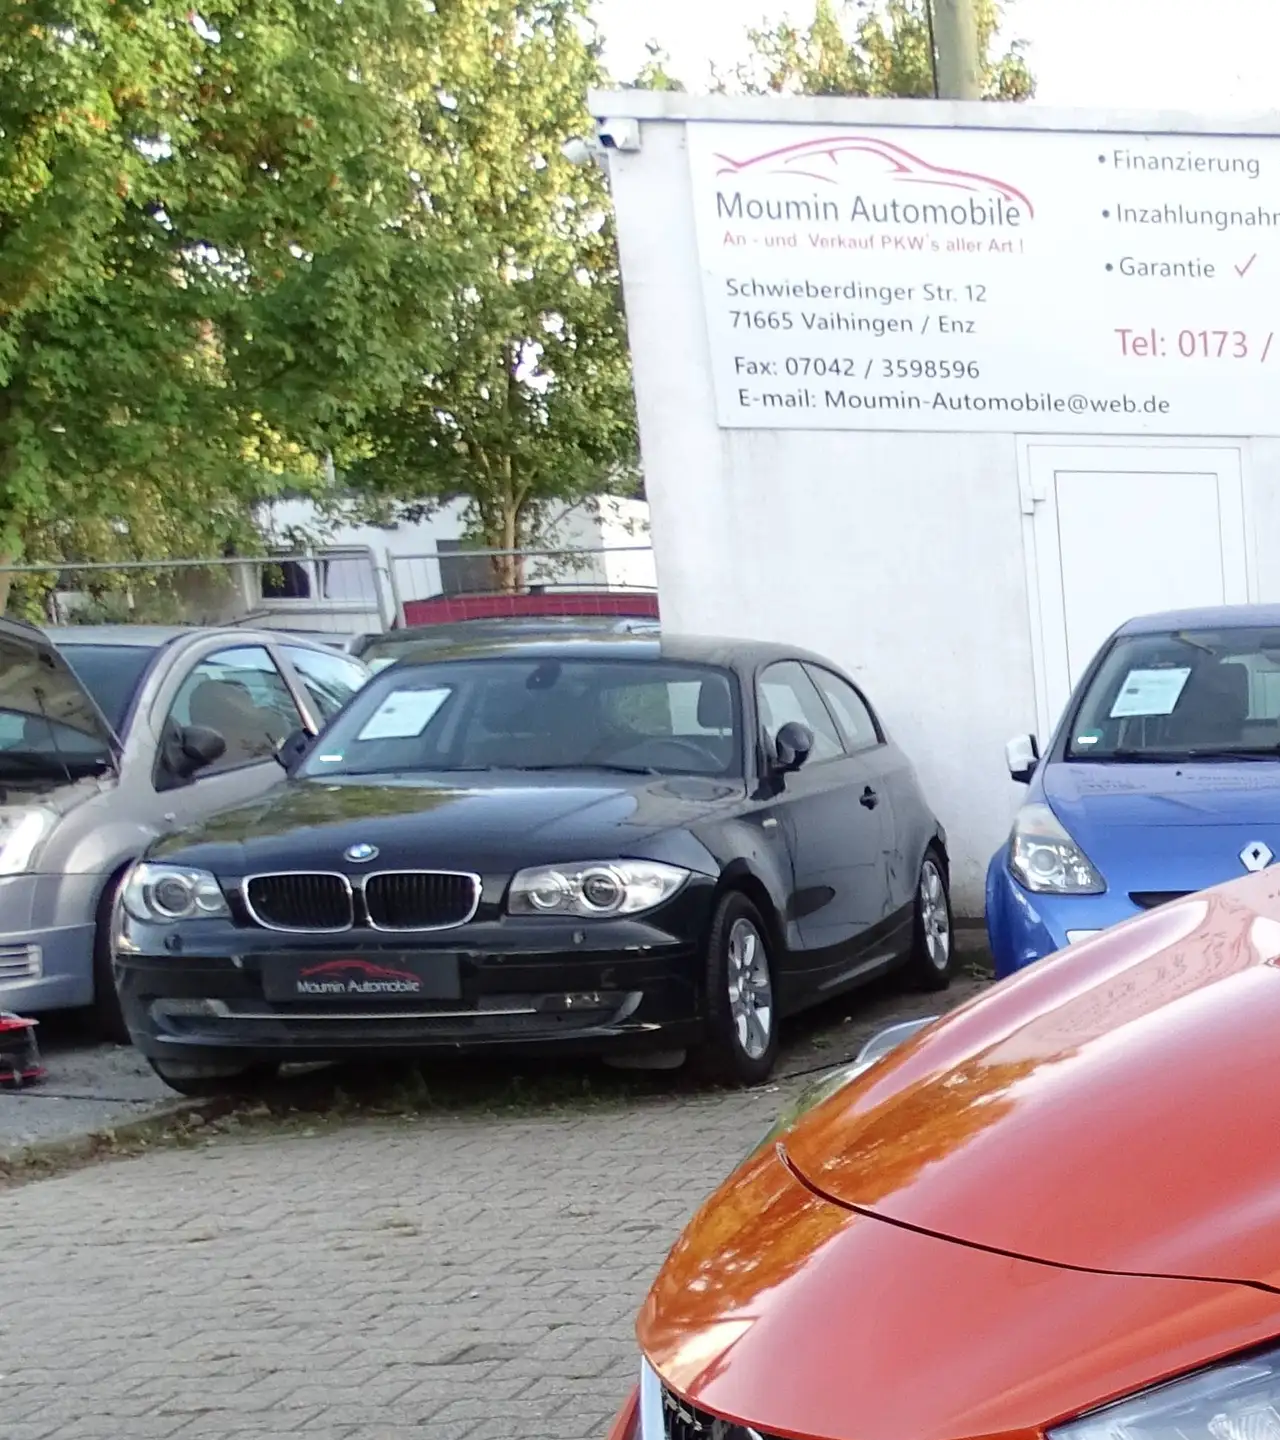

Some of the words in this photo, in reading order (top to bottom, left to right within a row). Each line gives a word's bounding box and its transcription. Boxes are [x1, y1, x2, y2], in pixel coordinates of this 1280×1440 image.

[1114, 150, 1260, 179] Finanzierung
[716, 191, 839, 222] Moumin
[850, 195, 1021, 226] Automobile
[723, 231, 747, 247] An
[765, 234, 797, 248] und
[808, 233, 874, 250] Verkauf
[946, 238, 982, 253] aller
[1119, 257, 1216, 278] Garantie
[726, 278, 915, 305] Schwieberdinger
[923, 283, 958, 302] Str.
[965, 285, 987, 303] 12
[729, 311, 793, 330] 71665
[802, 312, 913, 337] Vaihingen
[921, 315, 930, 334] /
[939, 316, 976, 333] Enz
[1114, 328, 1167, 357] Tel:
[1178, 330, 1248, 358] 0173
[1260, 332, 1274, 363] /
[734, 357, 777, 376] Fax:
[785, 358, 855, 377] 07042
[864, 359, 872, 379] /
[882, 360, 980, 379] 3598596
[739, 389, 816, 408] E-mail:
[825, 390, 1170, 413] Moumin-Automobile@web.de
[297, 980, 346, 993] Moumin
[348, 979, 420, 993] Automobile
